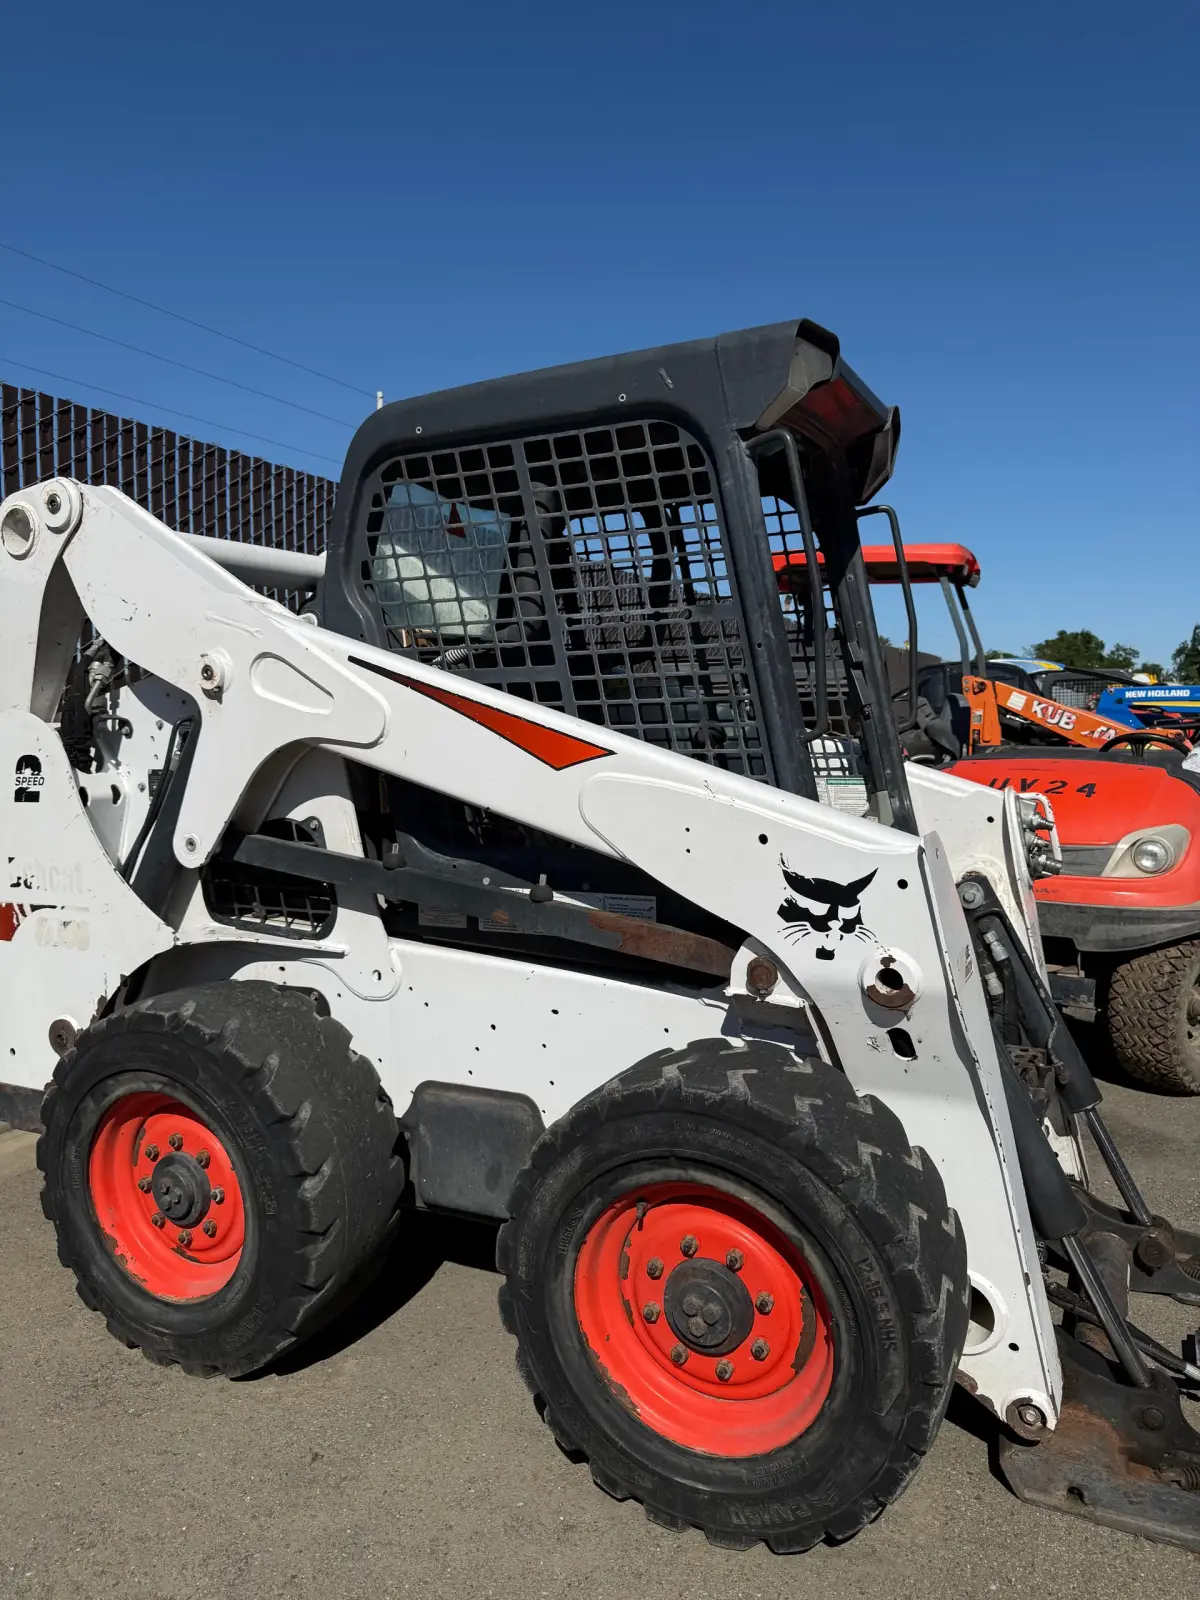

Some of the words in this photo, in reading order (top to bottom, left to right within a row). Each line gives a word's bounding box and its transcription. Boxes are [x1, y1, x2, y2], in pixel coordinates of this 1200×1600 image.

[1125, 690, 1146, 698] NEW
[1147, 689, 1190, 697] HOLLAND
[1031, 699, 1117, 741] KUBTA
[14, 776, 45, 787] SPEED
